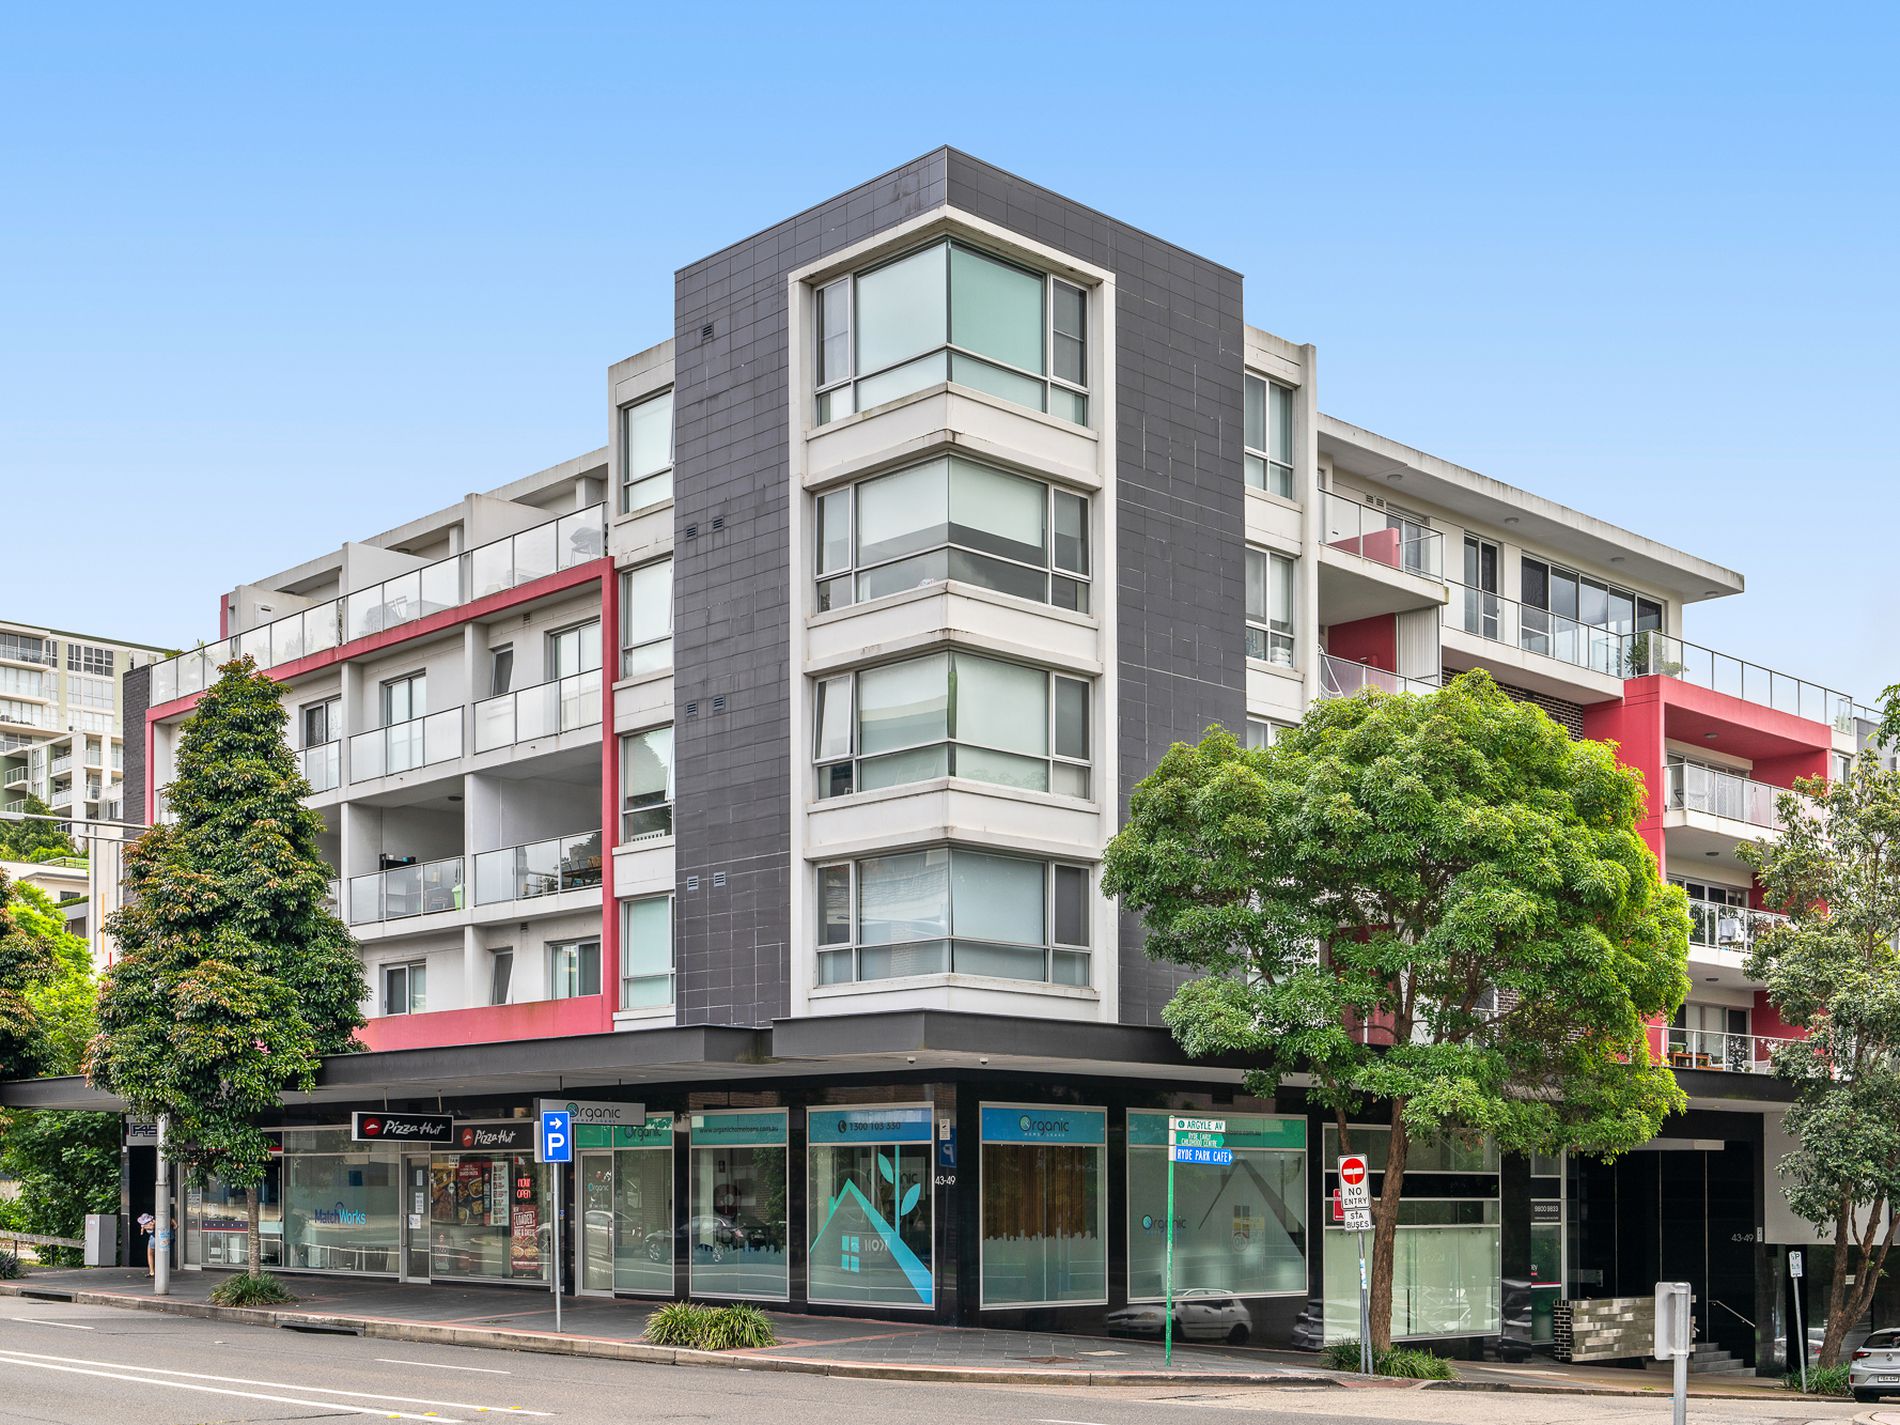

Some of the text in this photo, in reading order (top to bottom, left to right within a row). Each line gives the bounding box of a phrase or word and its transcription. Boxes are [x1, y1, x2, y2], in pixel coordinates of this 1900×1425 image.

[565, 1102, 621, 1122] Organic
[382, 1119, 446, 1135] Pizza Hut
[624, 1124, 662, 1140] Organic
[849, 1121, 869, 1131] 1300
[1018, 1114, 1070, 1135] Organic
[1186, 1121, 1224, 1131] ARGYLE AV
[474, 1129, 517, 1146] Pizza Hut
[547, 1132, 565, 1157] P
[1177, 1148, 1229, 1163] RYDE PARK CAFE
[934, 1175, 956, 1185] 43-49
[1348, 1187, 1362, 1196] NO
[1344, 1197, 1368, 1206] ENTRY
[314, 1208, 367, 1225] MatchWorks
[1142, 1214, 1187, 1232] Orgnic
[1350, 1212, 1364, 1220] STA
[1346, 1220, 1370, 1229] BUSES
[1731, 1233, 1754, 1243] 43-49
